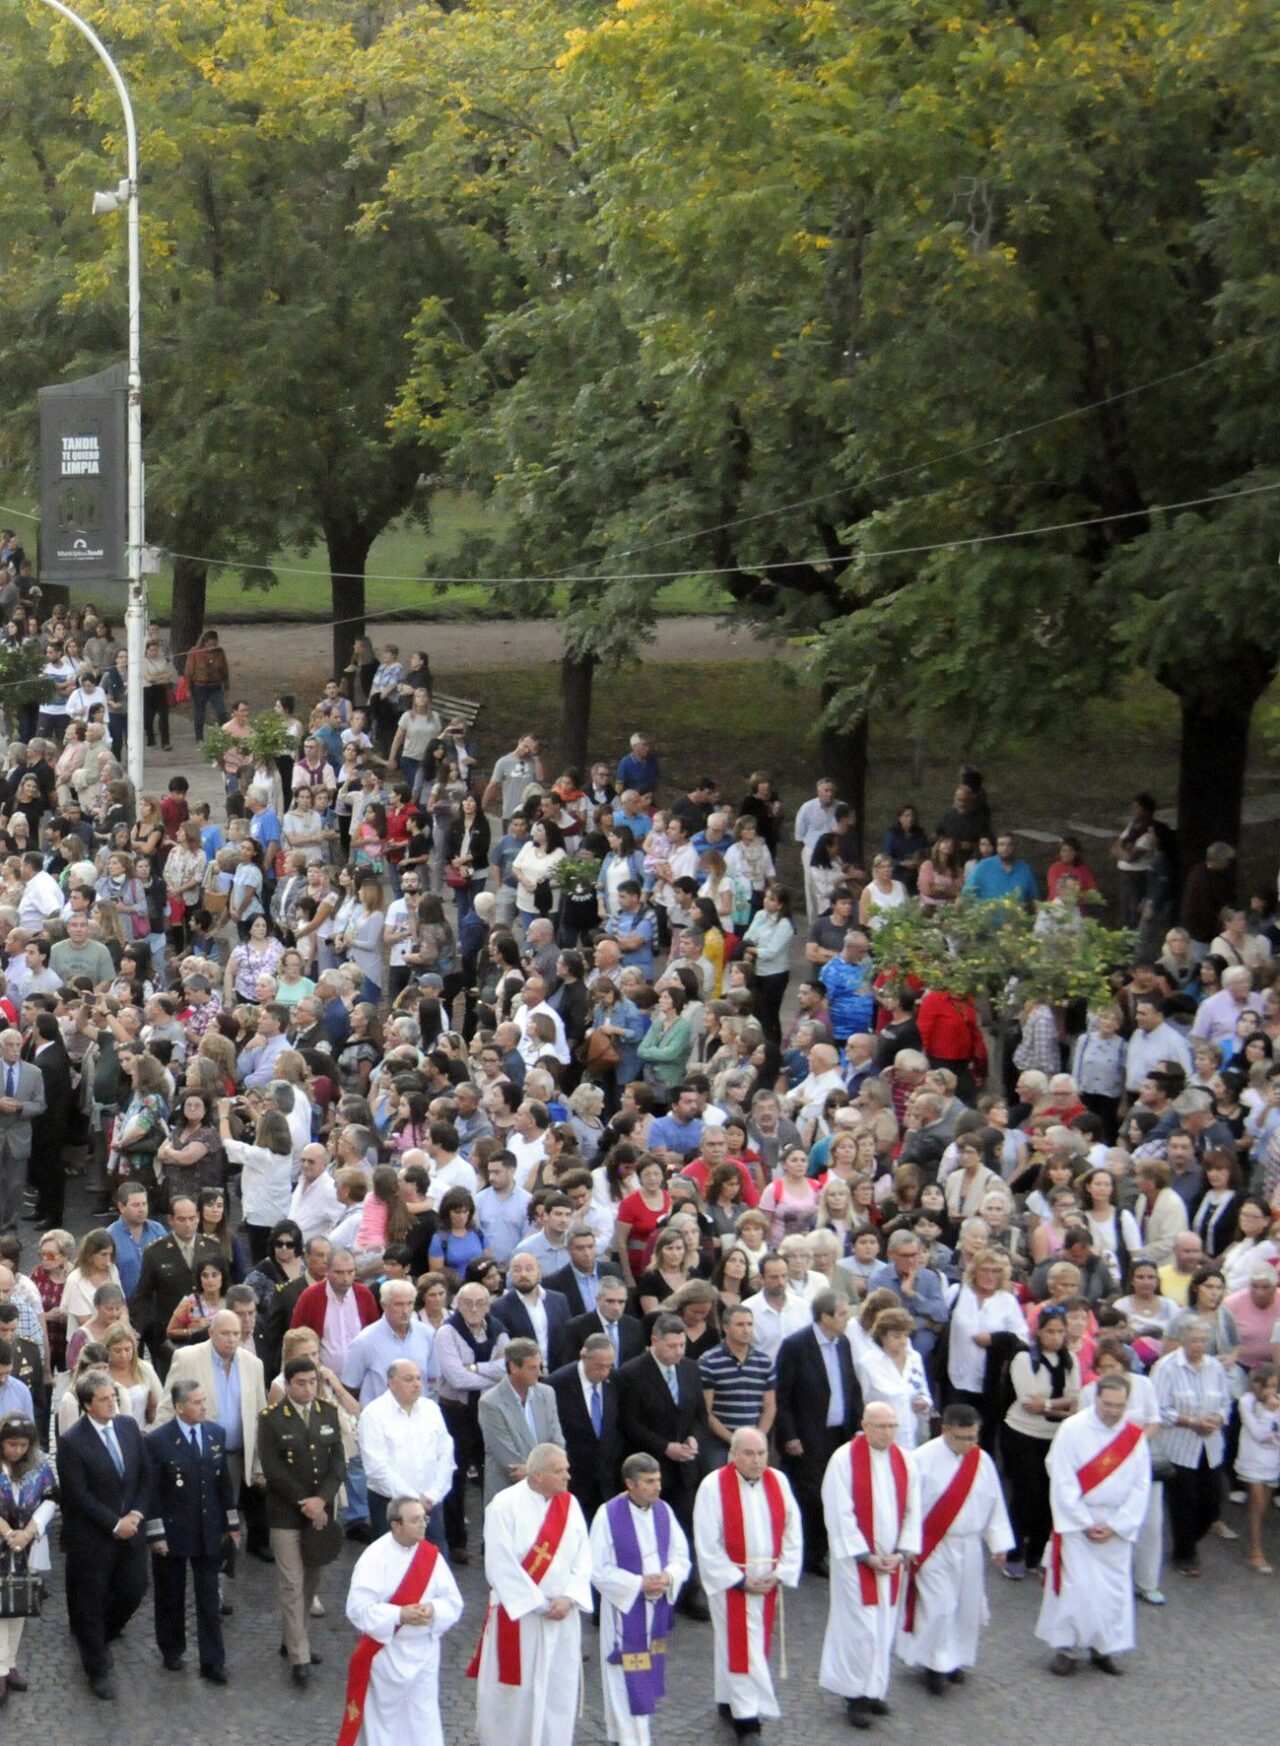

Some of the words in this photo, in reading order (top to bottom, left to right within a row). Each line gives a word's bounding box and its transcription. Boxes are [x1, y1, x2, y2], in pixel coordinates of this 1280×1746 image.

[61, 437, 99, 450] TANDIL
[62, 451, 71, 461] TE
[72, 450, 100, 461] QUIERO
[61, 461, 100, 474] LIMPIA
